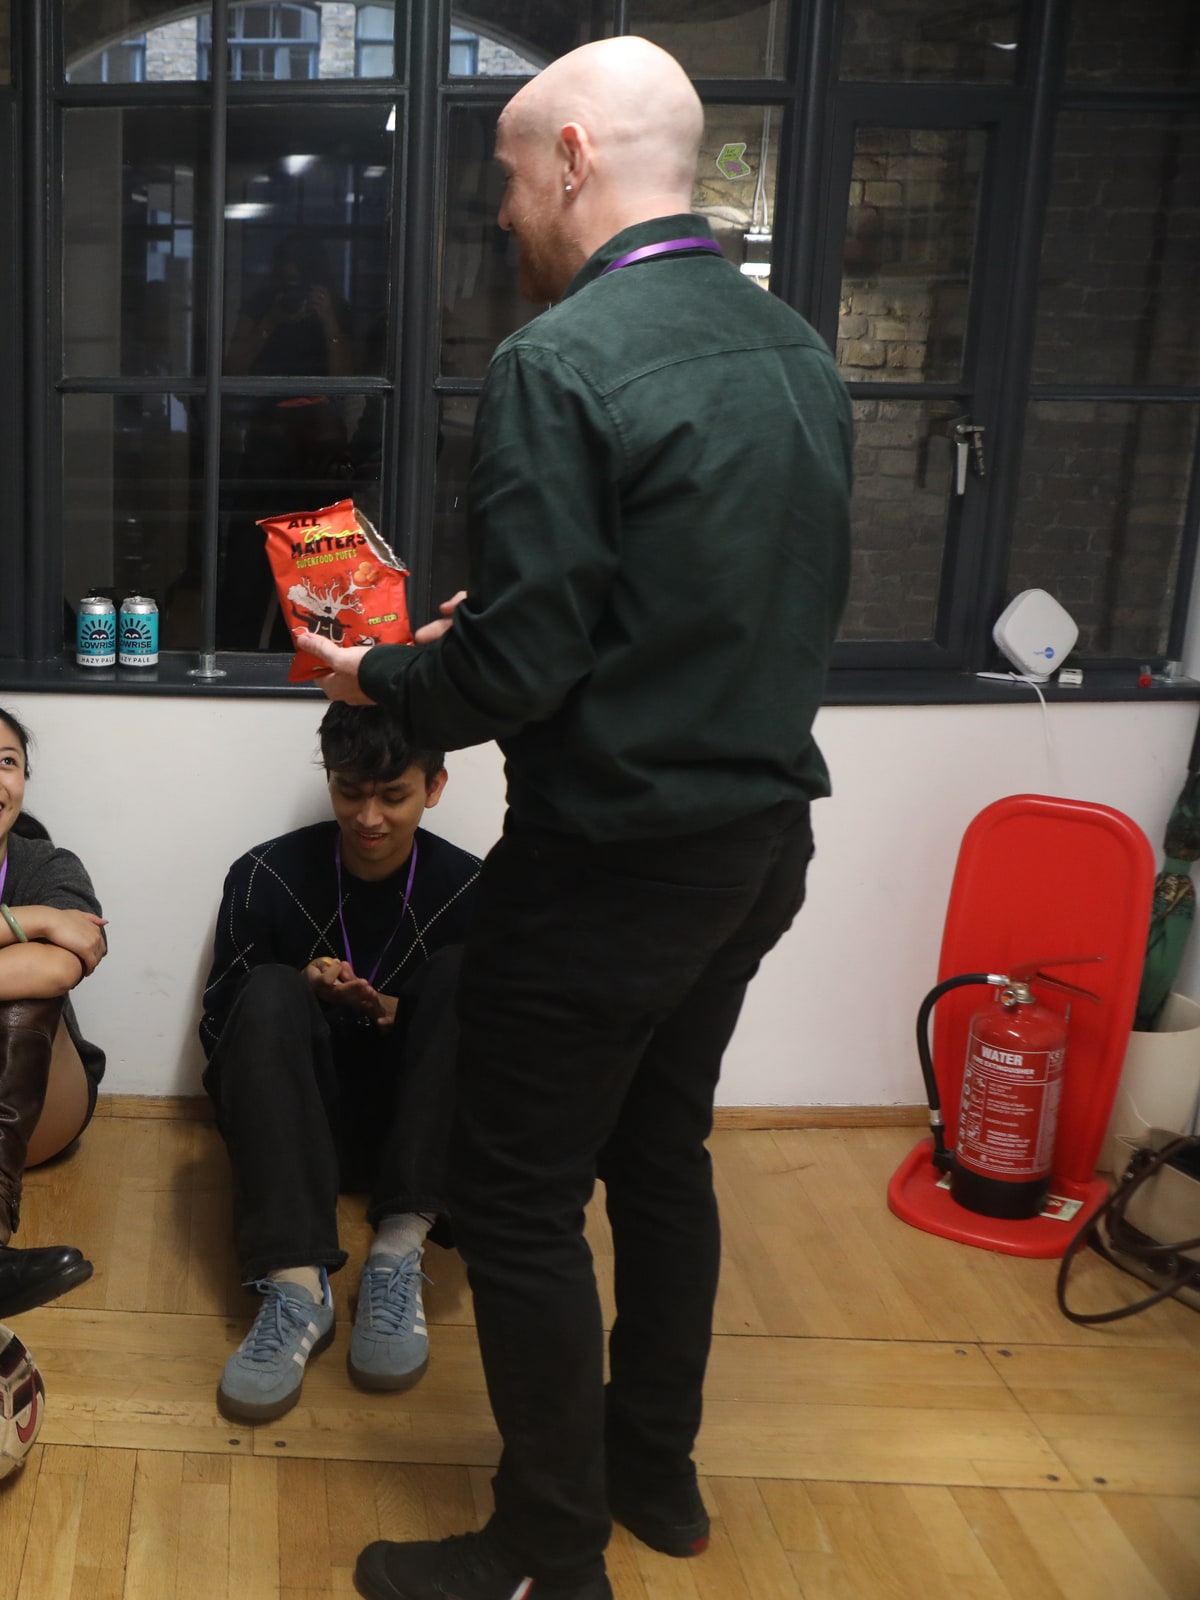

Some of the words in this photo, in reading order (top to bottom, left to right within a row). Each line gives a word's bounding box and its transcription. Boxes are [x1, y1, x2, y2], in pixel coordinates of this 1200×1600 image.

[287, 518, 321, 530] ALL
[291, 533, 367, 559] MATTERS
[296, 553, 334, 568] SUPERFOOD
[981, 1045, 1024, 1067] WATER
